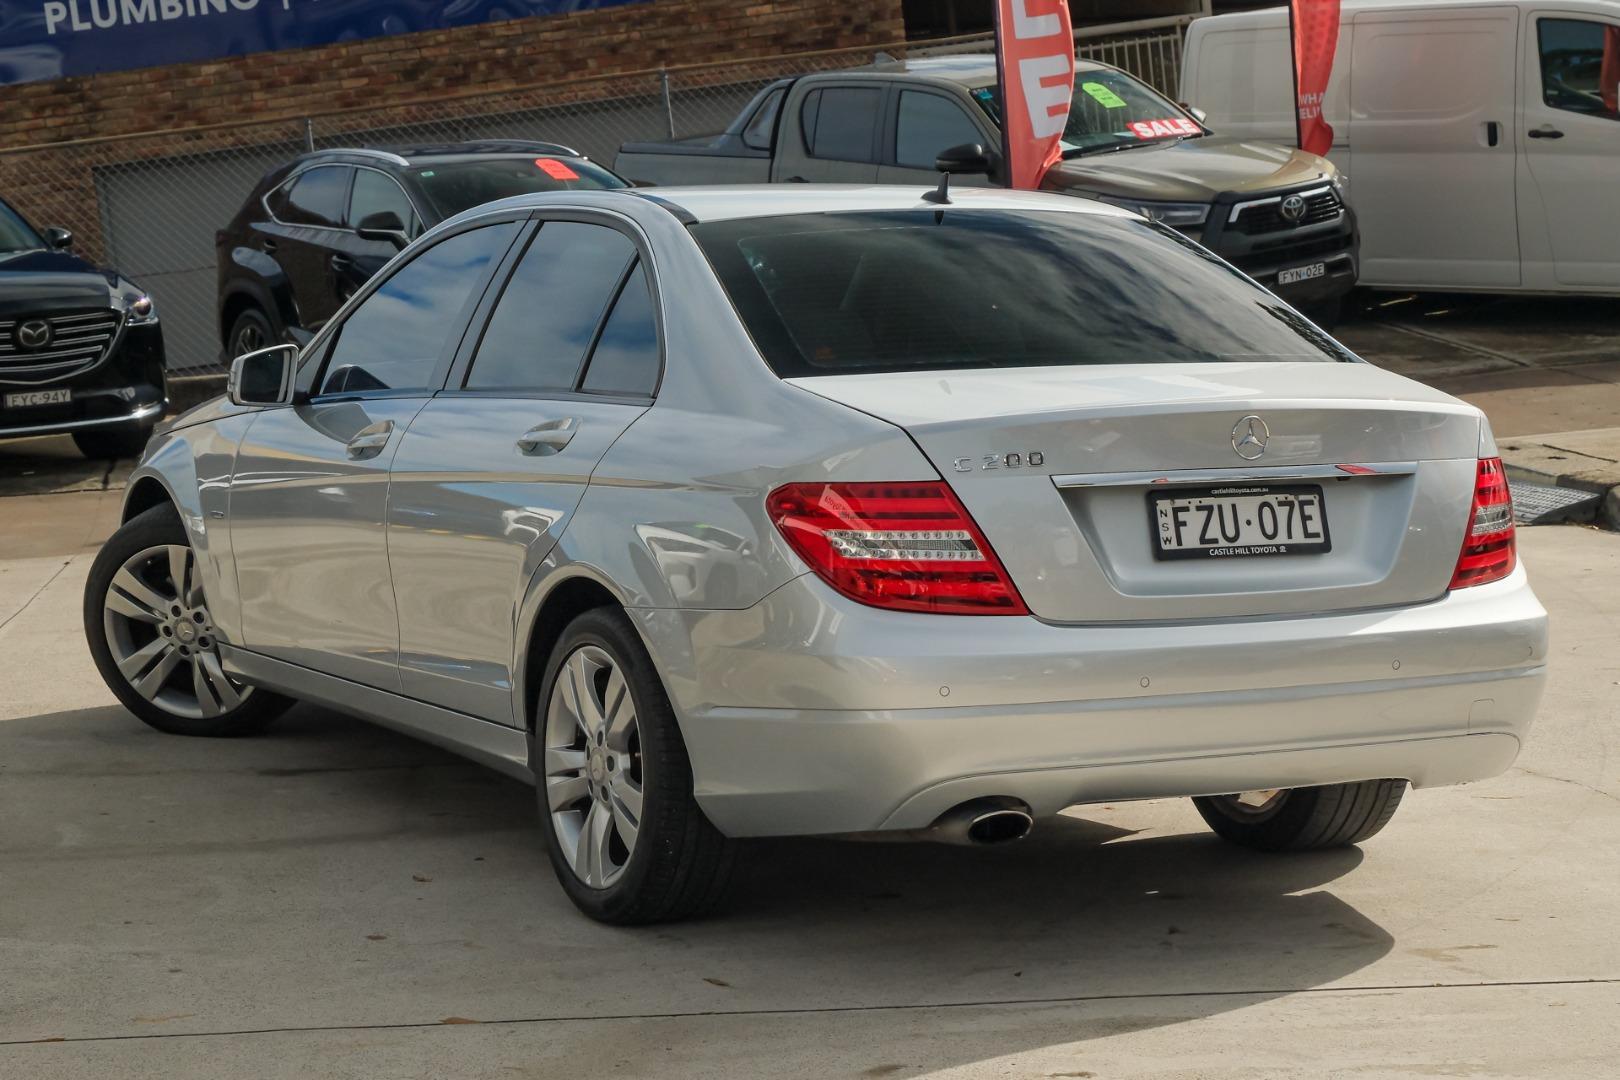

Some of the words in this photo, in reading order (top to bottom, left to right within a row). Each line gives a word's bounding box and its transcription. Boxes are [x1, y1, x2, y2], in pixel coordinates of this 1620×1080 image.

[1133, 118, 1198, 138] SALE
[954, 456, 973, 473] C
[982, 450, 1045, 471] 200
[1209, 547, 1234, 556] CASTLE
[1235, 546, 1250, 555] HILL
[1250, 545, 1278, 554] TOYOTA
